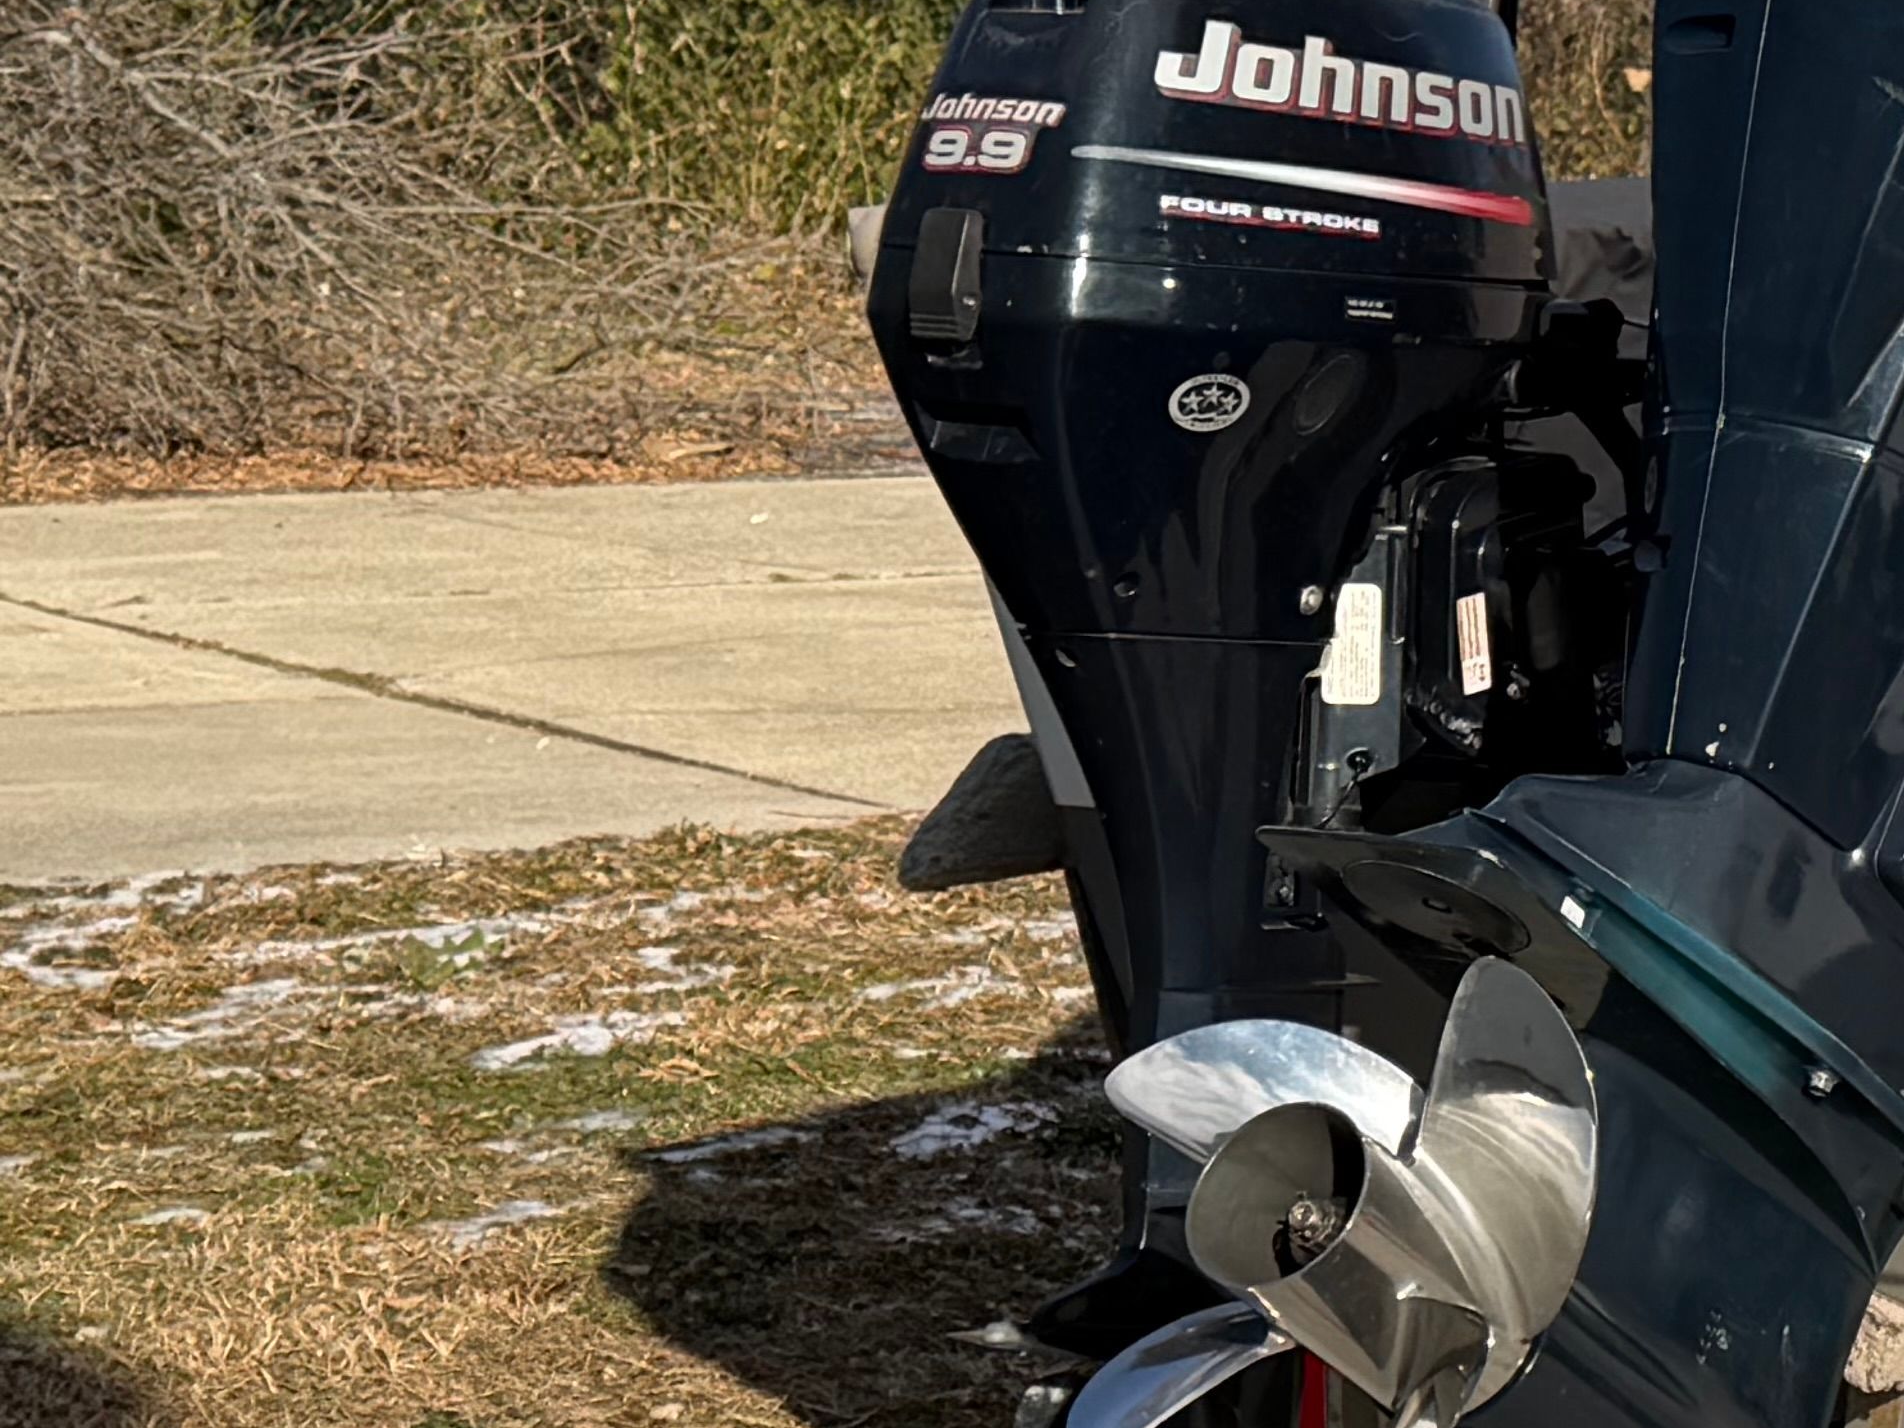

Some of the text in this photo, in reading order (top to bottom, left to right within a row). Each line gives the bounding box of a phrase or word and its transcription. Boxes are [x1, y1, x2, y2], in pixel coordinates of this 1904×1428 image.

[1154, 19, 1527, 144] Johnson
[923, 93, 1065, 127] Johnson
[924, 128, 1028, 170] 9.9
[1160, 194, 1380, 234] FOUR STROKE
